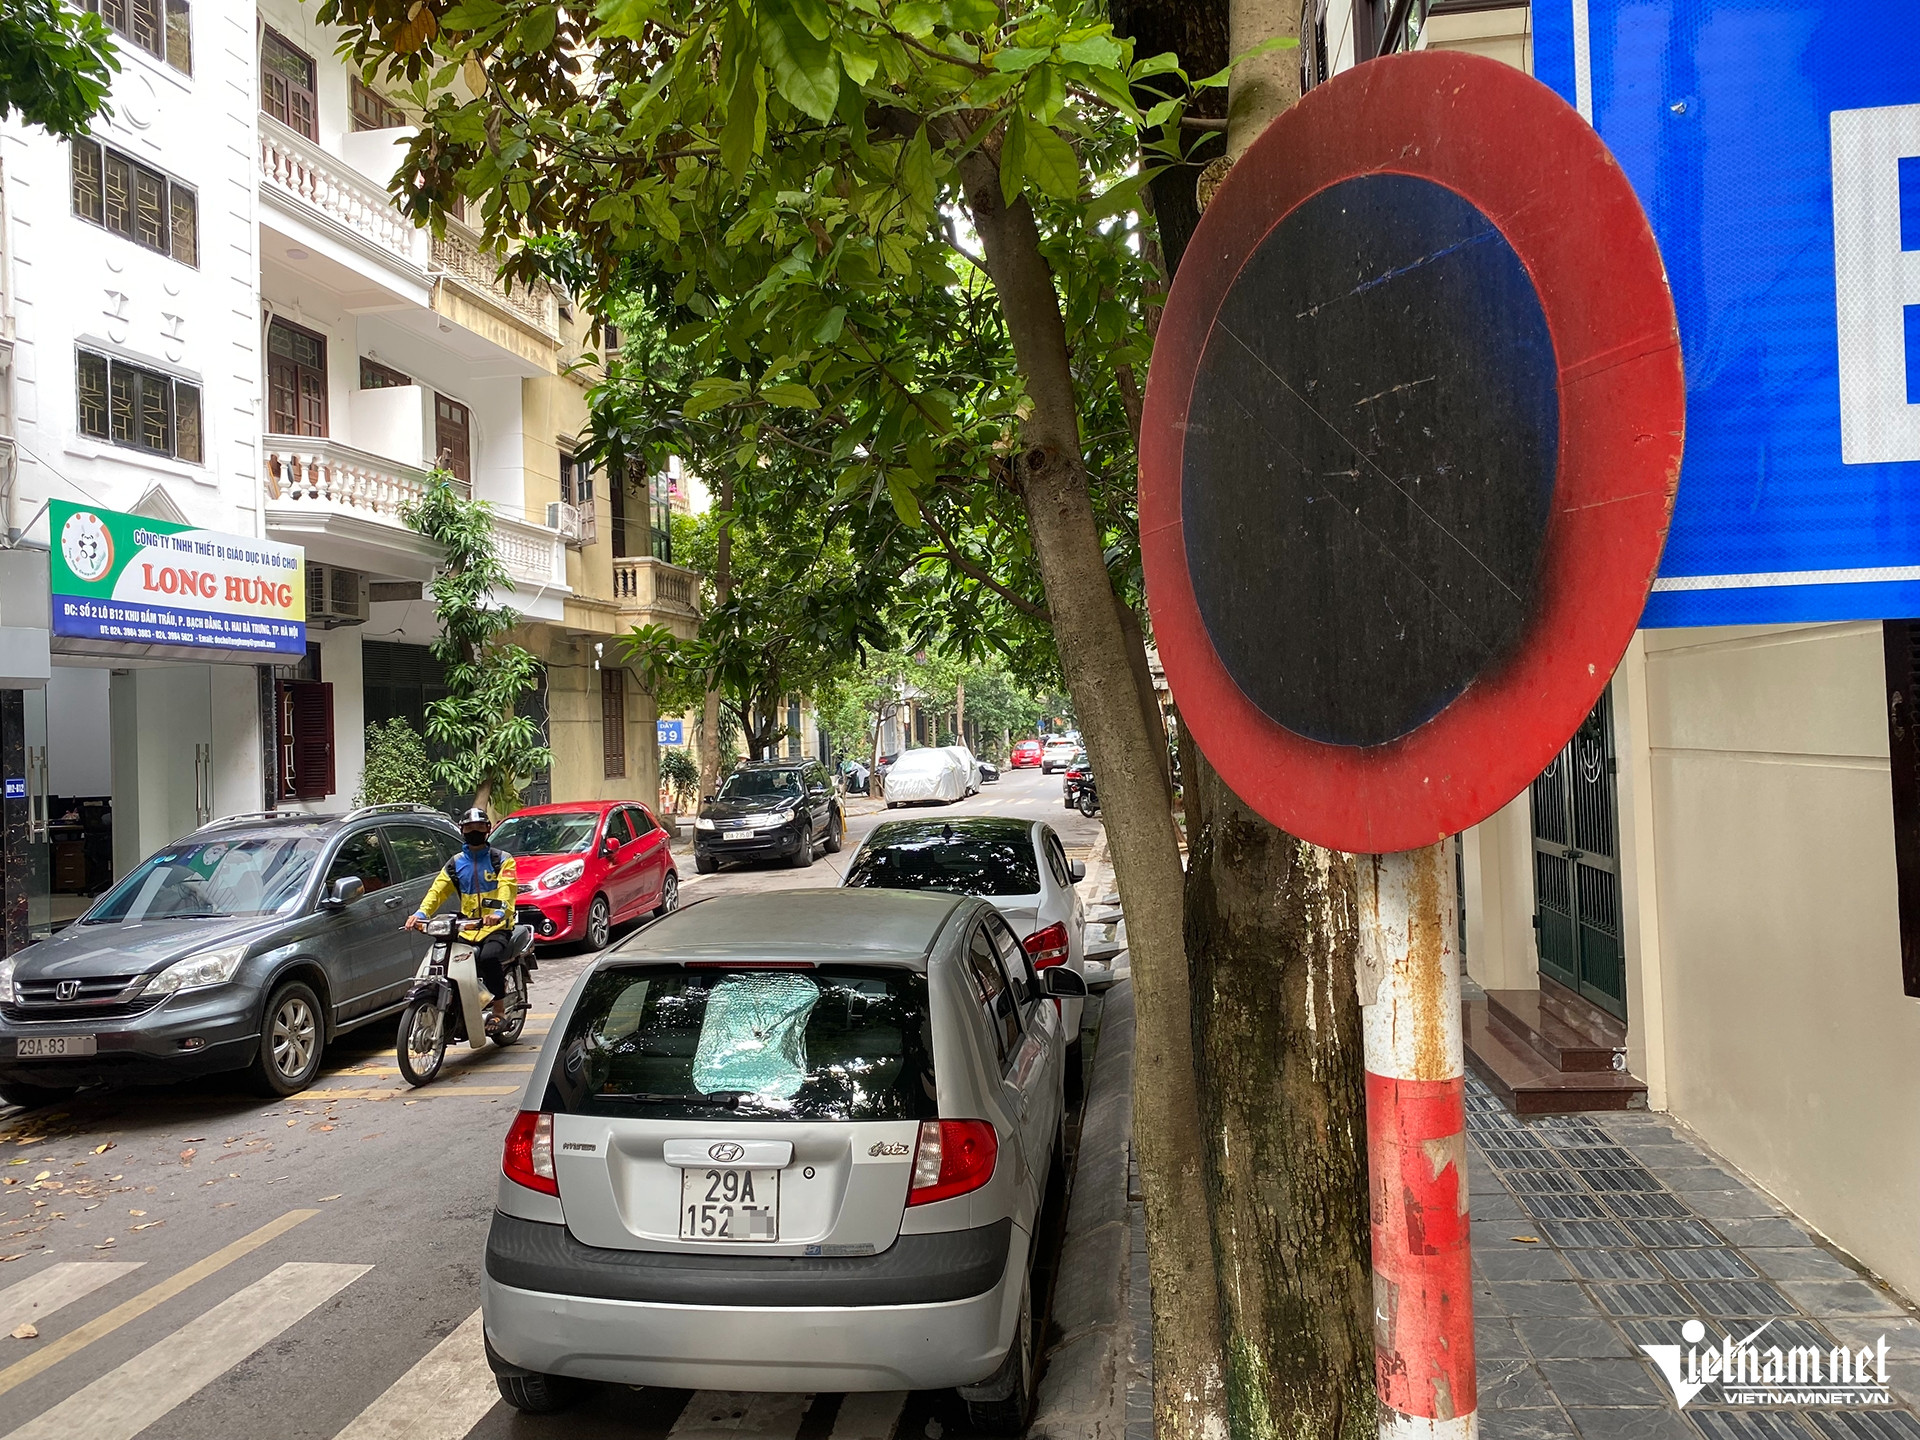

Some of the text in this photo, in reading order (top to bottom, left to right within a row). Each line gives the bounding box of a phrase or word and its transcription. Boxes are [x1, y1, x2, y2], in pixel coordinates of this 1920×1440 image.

[134, 529, 158, 547] CÔNG
[160, 535, 170, 549] TY
[172, 537, 193, 553] TNHH
[194, 540, 215, 557] THIẾT
[217, 546, 226, 562] BỊ
[226, 547, 244, 561] GIÁO
[245, 551, 260, 566] DỤC
[260, 551, 270, 566] VÀ
[282, 556, 298, 570] CHƠI
[142, 563, 294, 608] LONG HƯNG
[64, 603, 78, 616] ĐC:
[79, 602, 91, 617] SỐ
[92, 607, 98, 618] 2
[98, 605, 109, 619] LÔ
[109, 608, 124, 620] B12
[125, 610, 140, 622] KHU
[178, 616, 186, 627] P.
[186, 616, 204, 630] BẠCH
[224, 620, 231, 632] Q.
[231, 621, 242, 632] HAI
[242, 620, 251, 633] BÀ
[272, 625, 280, 635] TP.
[280, 624, 288, 637] HÀ
[868, 1141, 910, 1157] Getz
[705, 1169, 755, 1203] 29A
